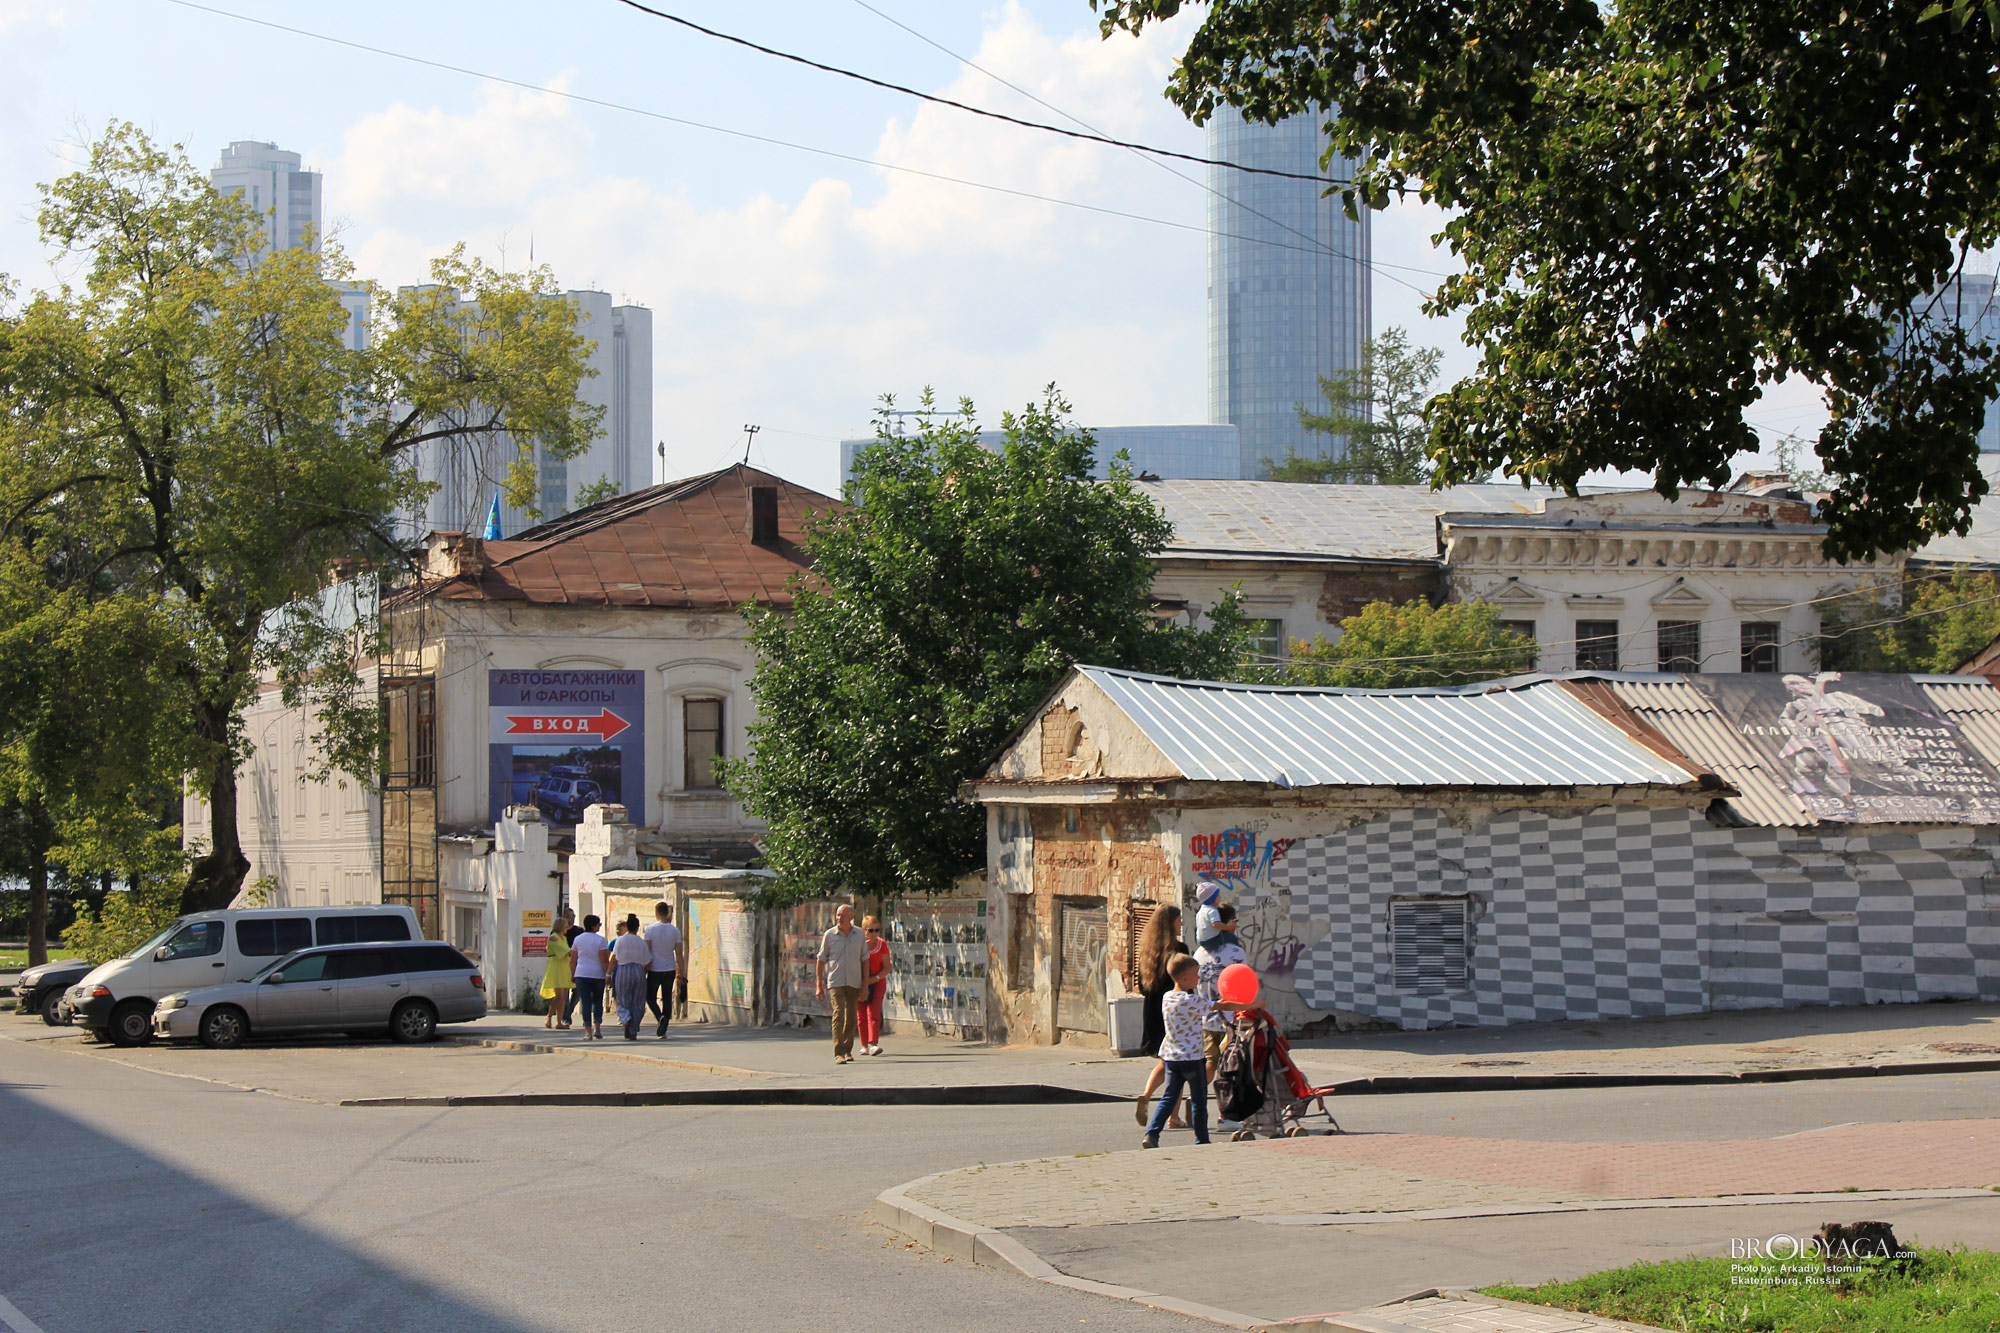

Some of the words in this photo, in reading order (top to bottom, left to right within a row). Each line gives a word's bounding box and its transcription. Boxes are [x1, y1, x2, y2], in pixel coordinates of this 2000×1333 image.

[499, 672, 636, 686] АВТОБАГАЖНИКИ
[520, 690, 531, 702] И
[535, 690, 615, 703] ФАРКОПЫ
[533, 719, 590, 732] ВХОД
